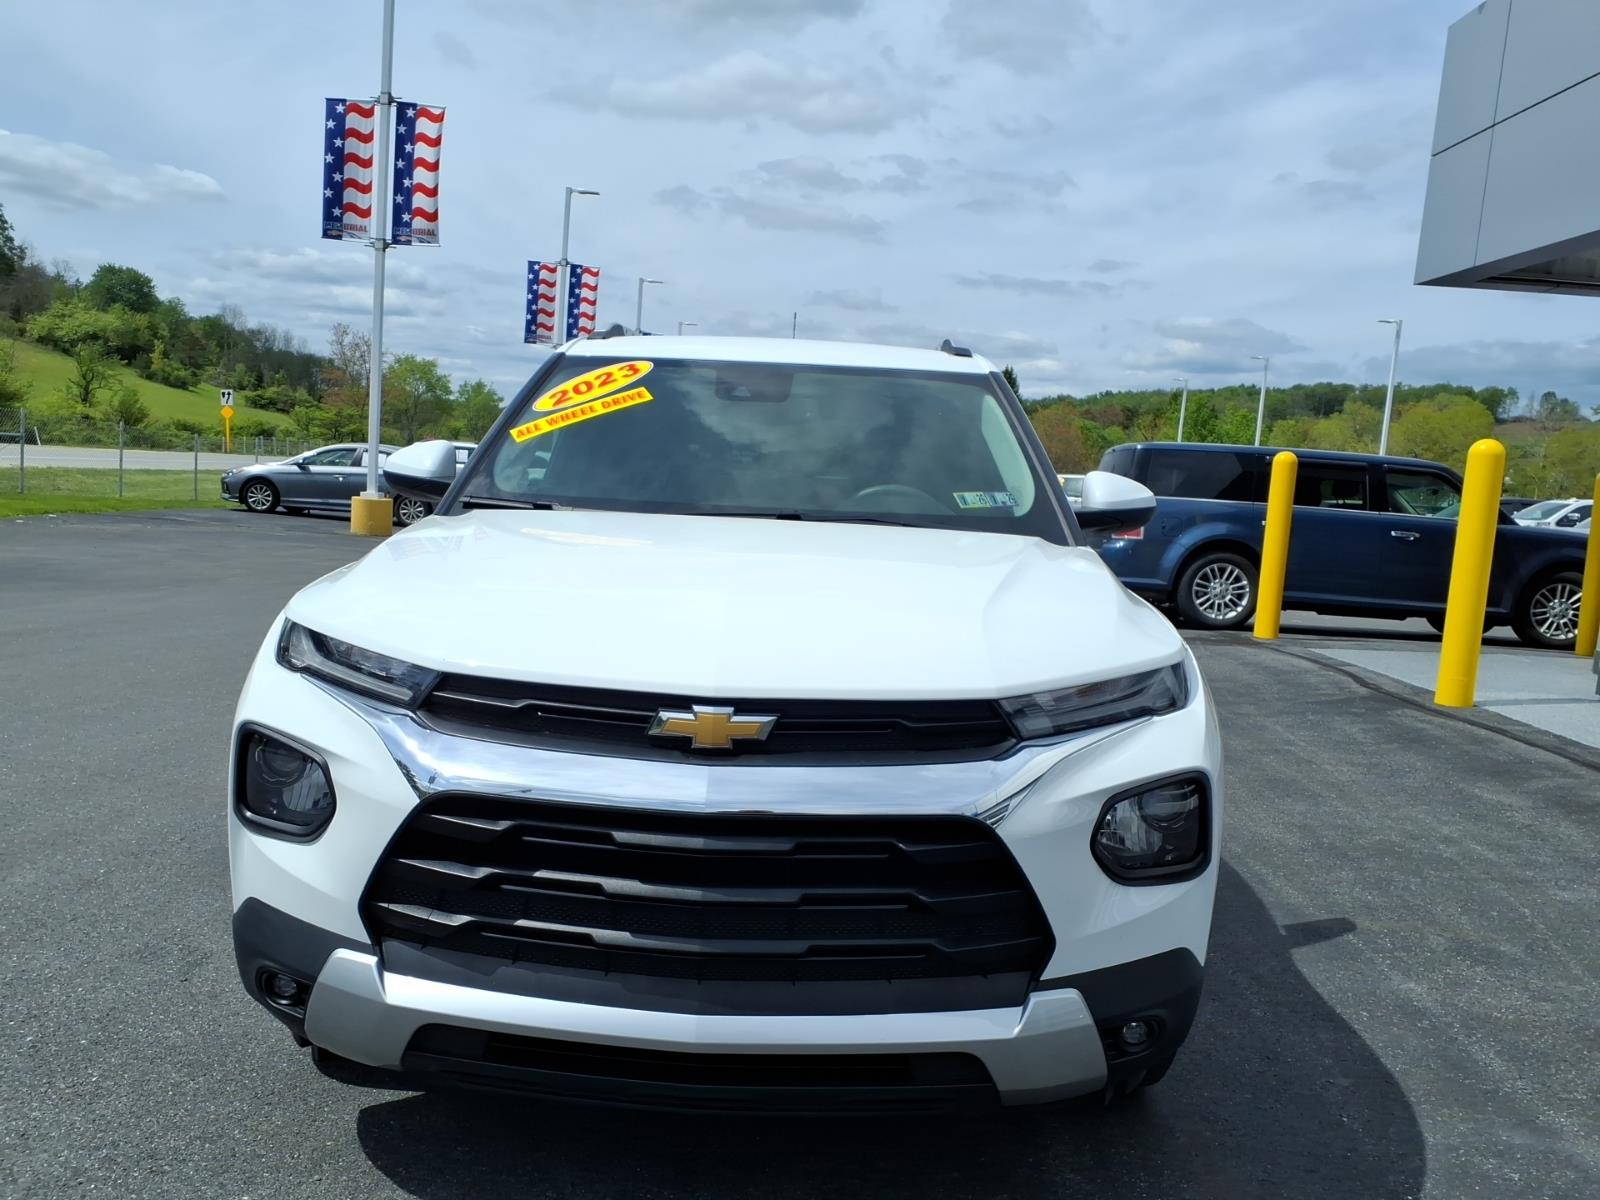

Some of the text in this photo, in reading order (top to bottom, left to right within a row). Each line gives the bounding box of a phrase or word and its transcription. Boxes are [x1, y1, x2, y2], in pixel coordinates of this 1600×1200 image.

[549, 363, 641, 407] 2023
[516, 390, 646, 439] ALL WHEEL DRIVE
